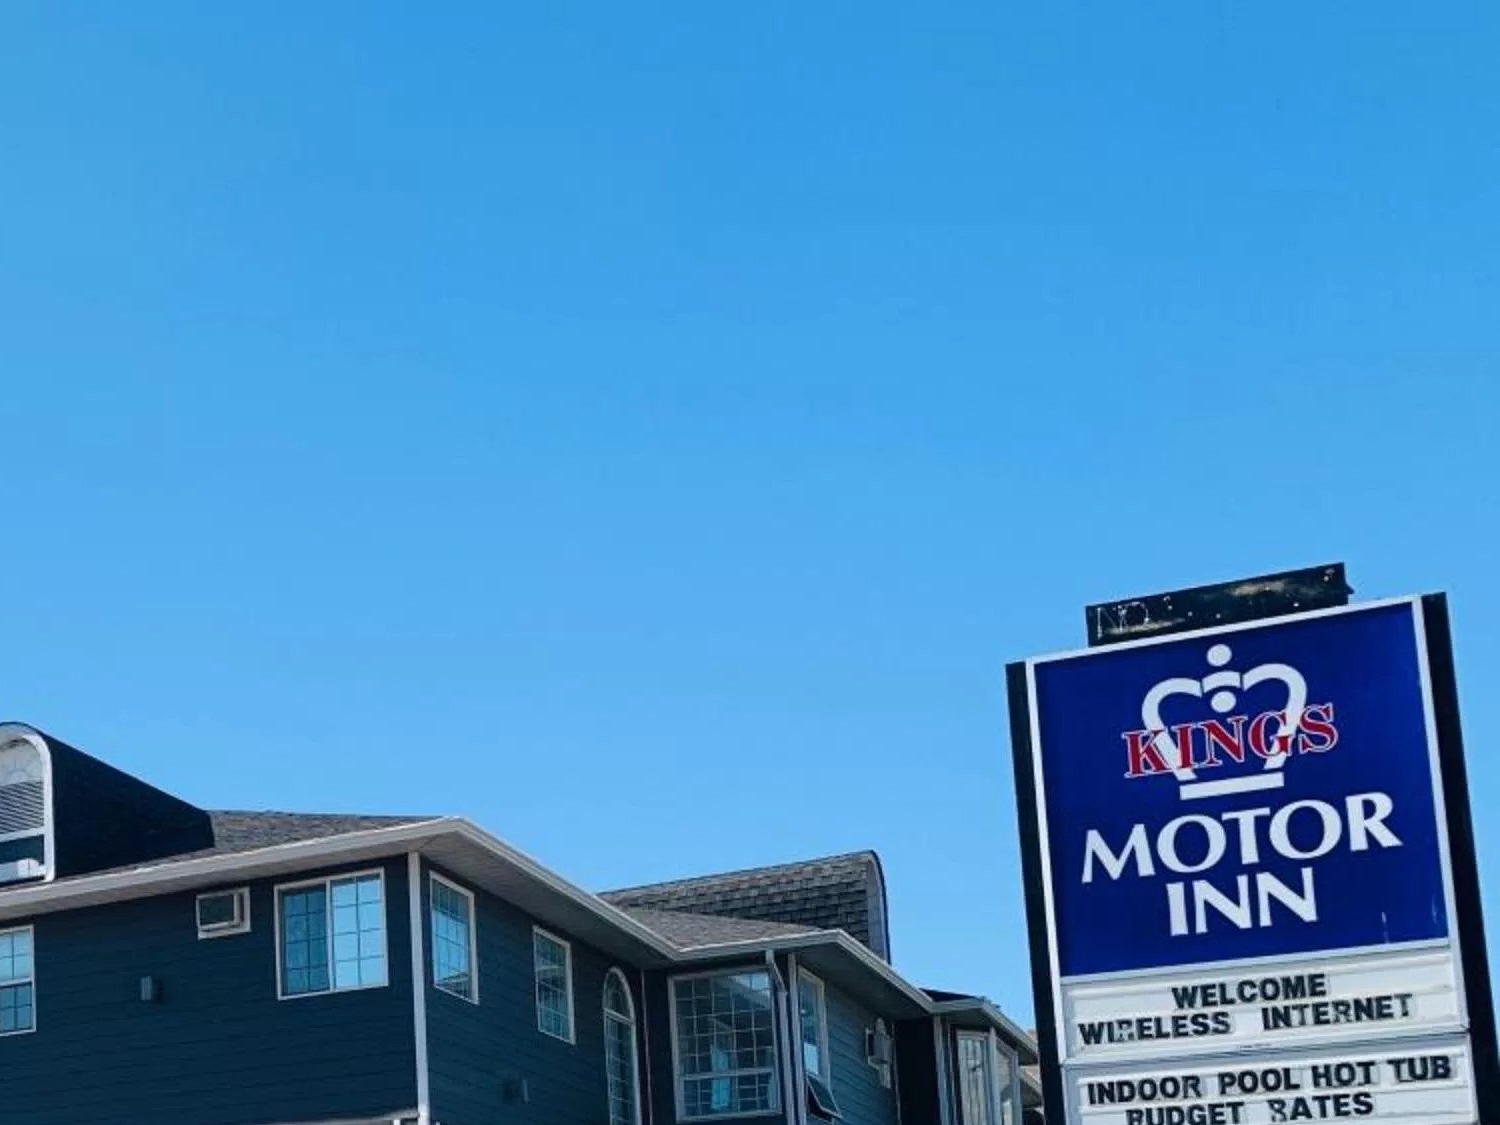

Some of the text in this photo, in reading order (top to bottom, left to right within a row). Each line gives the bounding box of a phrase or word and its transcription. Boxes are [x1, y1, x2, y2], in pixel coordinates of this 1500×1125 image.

[1122, 702, 1339, 778] KINGS
[1082, 792, 1404, 884] MOTOR
[1166, 867, 1319, 937] INN
[1171, 973, 1327, 1010] WELCOME
[1077, 993, 1413, 1046] WIRELESS INTERNET
[1086, 1055, 1452, 1105] INDOOR POOL HOT TUB
[1268, 1091, 1374, 1123] RATES
